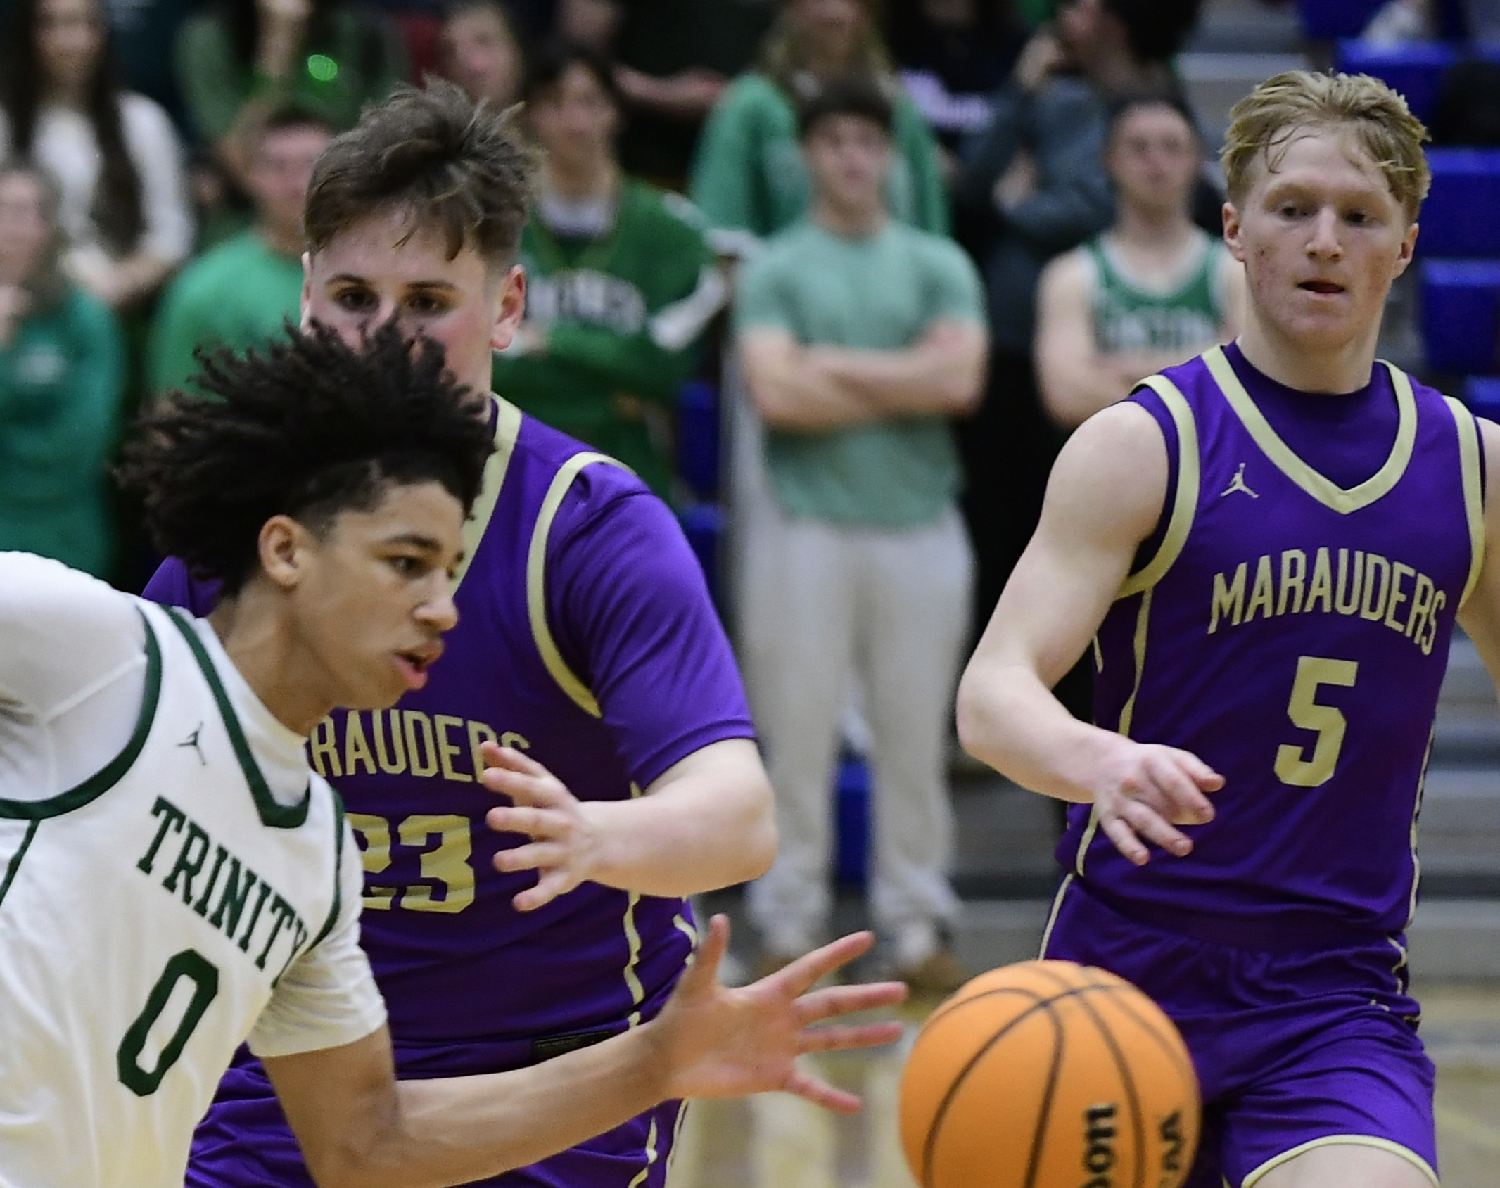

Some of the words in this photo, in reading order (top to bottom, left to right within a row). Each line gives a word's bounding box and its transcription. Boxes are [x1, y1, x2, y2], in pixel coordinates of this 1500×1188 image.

[1207, 546, 1447, 656] MARAUDERS
[309, 707, 530, 785] RAUDER
[1273, 655, 1359, 787] 5
[136, 795, 308, 987] TRINITY
[342, 812, 475, 913] 23
[116, 947, 219, 1098] 0
